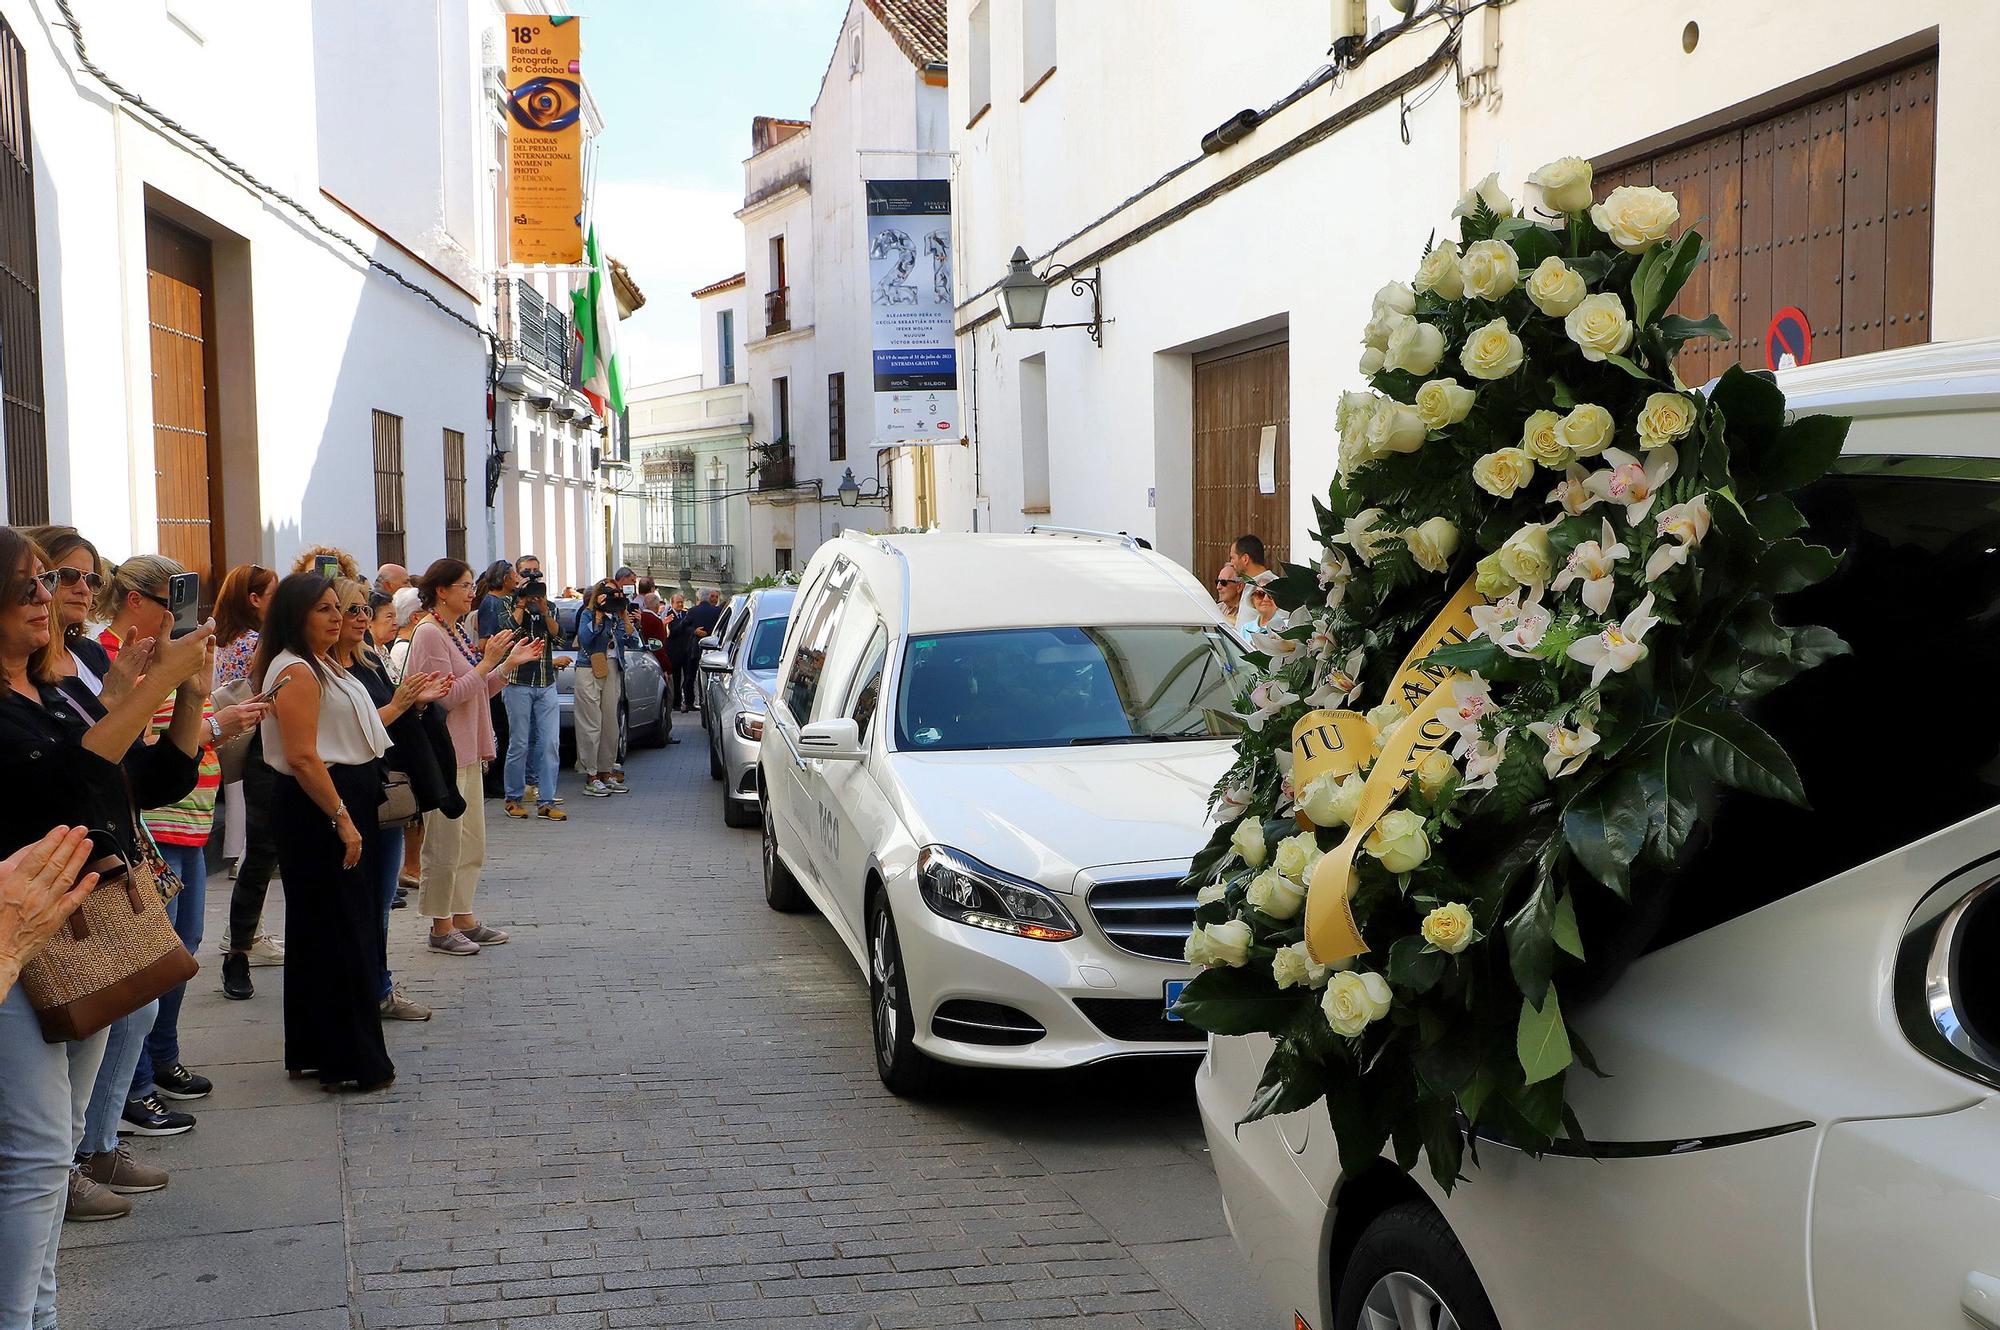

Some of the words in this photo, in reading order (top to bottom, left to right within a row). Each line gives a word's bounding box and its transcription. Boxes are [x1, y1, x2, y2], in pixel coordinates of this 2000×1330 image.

[512, 46, 538, 55] Bienal
[540, 47, 552, 55] de
[513, 152, 572, 160] INTERNACIONAL
[513, 167, 539, 175] PHOTO
[1295, 724, 1344, 761] TU
